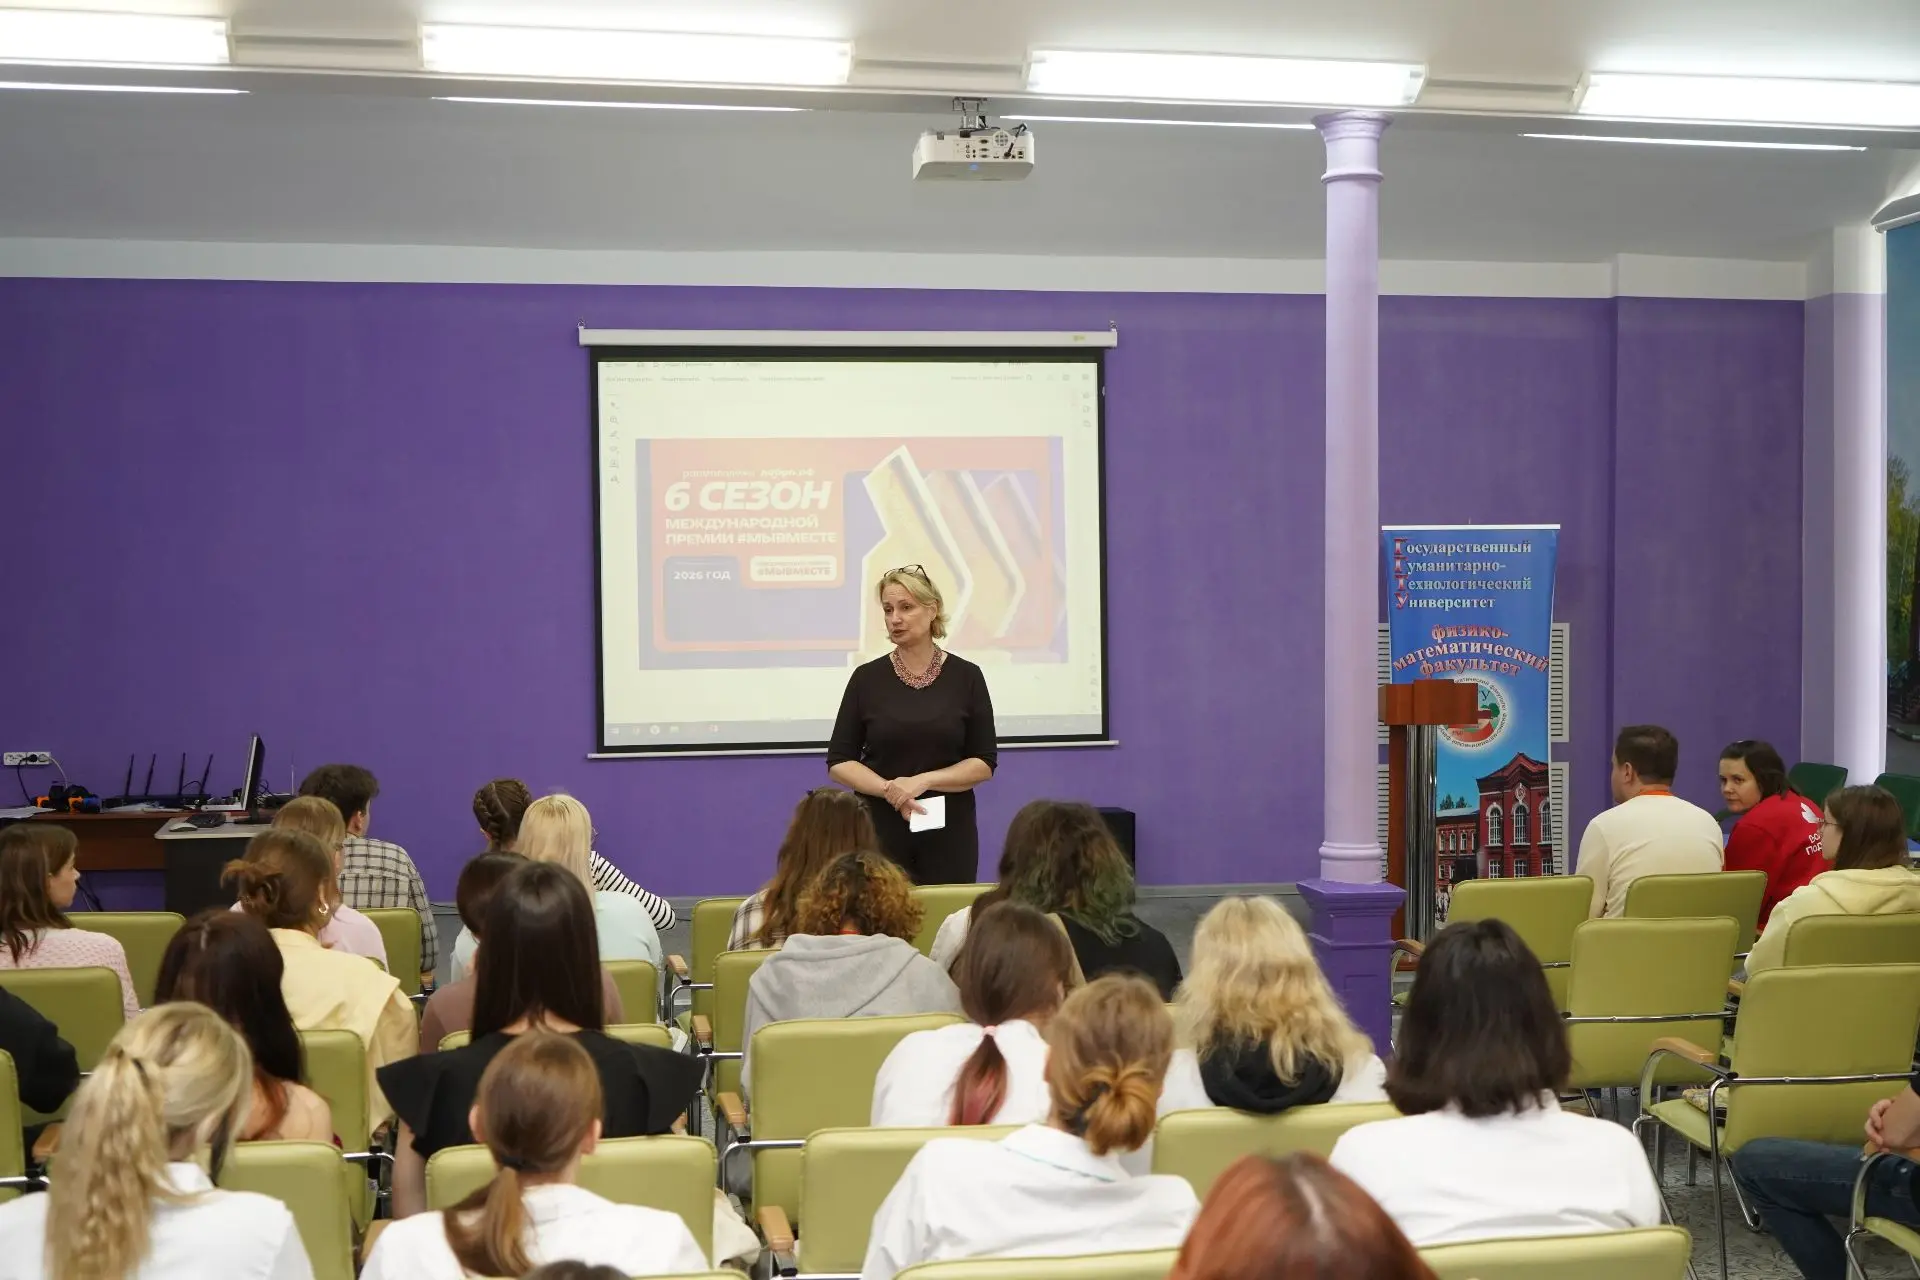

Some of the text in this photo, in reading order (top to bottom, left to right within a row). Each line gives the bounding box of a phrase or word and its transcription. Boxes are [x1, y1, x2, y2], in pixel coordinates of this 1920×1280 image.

[664, 480, 833, 511] 6 СЕЗОН
[665, 515, 819, 531] МЕЖДУНАРОДНОЙ
[665, 533, 734, 545] ПРЕМИИ
[1394, 538, 1532, 556] Государственный
[1394, 556, 1507, 575] Гуманитарно-
[673, 571, 703, 580] 2026
[1394, 574, 1532, 592] Технологический
[1394, 592, 1496, 611] Университет
[1431, 624, 1509, 643] физико-
[1393, 641, 1550, 672] математический
[1419, 657, 1521, 679] факультет
